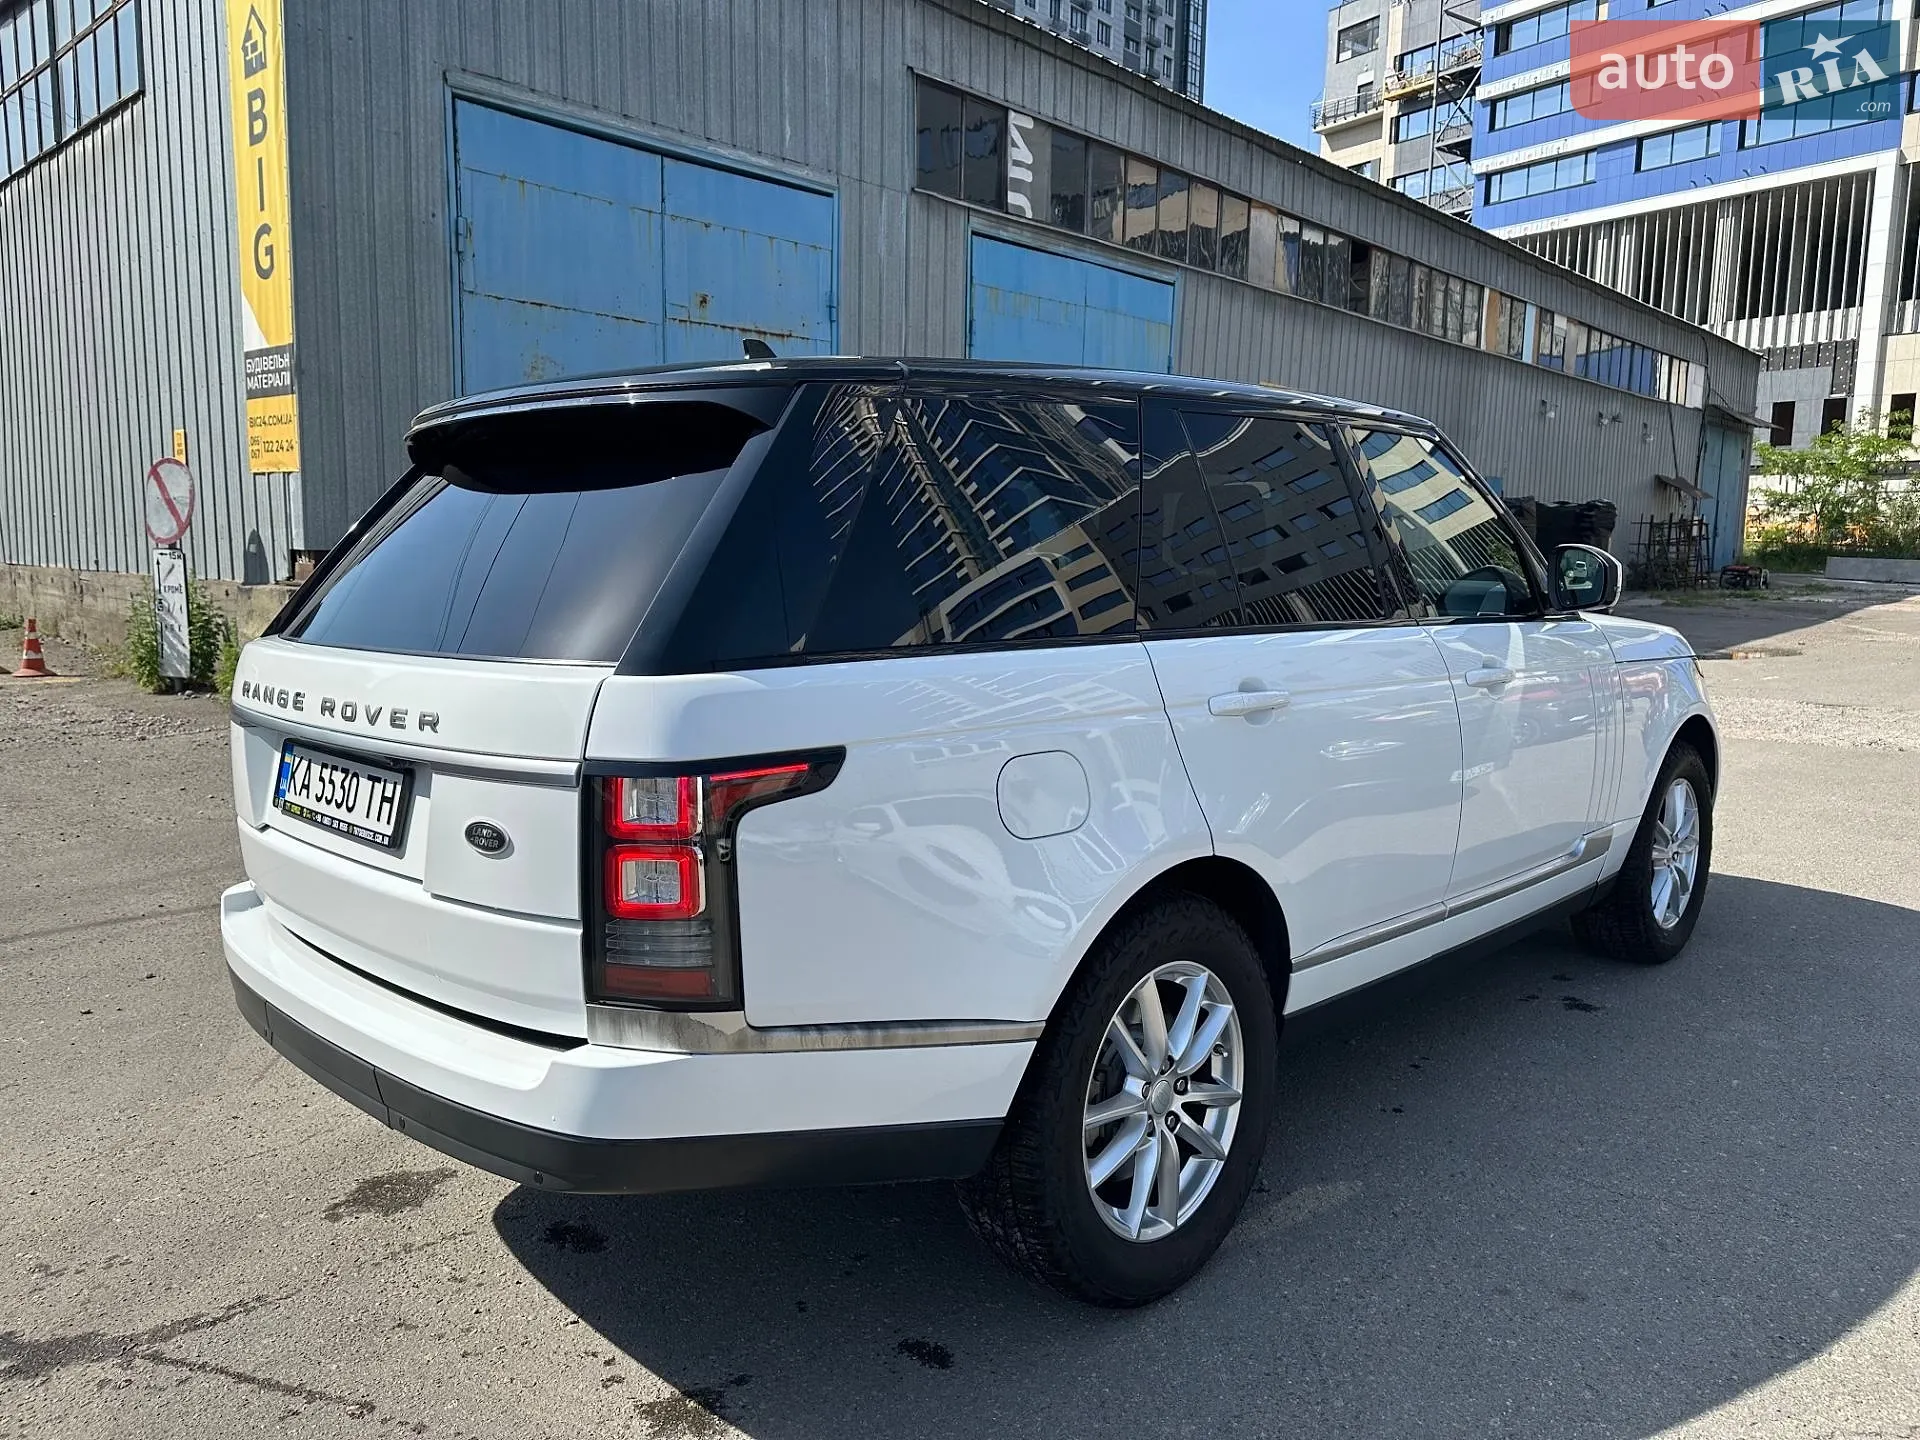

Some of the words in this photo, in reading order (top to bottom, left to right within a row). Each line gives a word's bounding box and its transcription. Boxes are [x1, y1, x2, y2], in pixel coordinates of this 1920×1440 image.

[247, 87, 275, 280] BIG
[246, 352, 290, 374] БУДІВЕЛЬН
[242, 680, 305, 712] RANGE
[321, 696, 440, 734] ROVER
[288, 755, 312, 800] KA
[315, 762, 360, 813] 5530
[366, 773, 398, 825] TH
